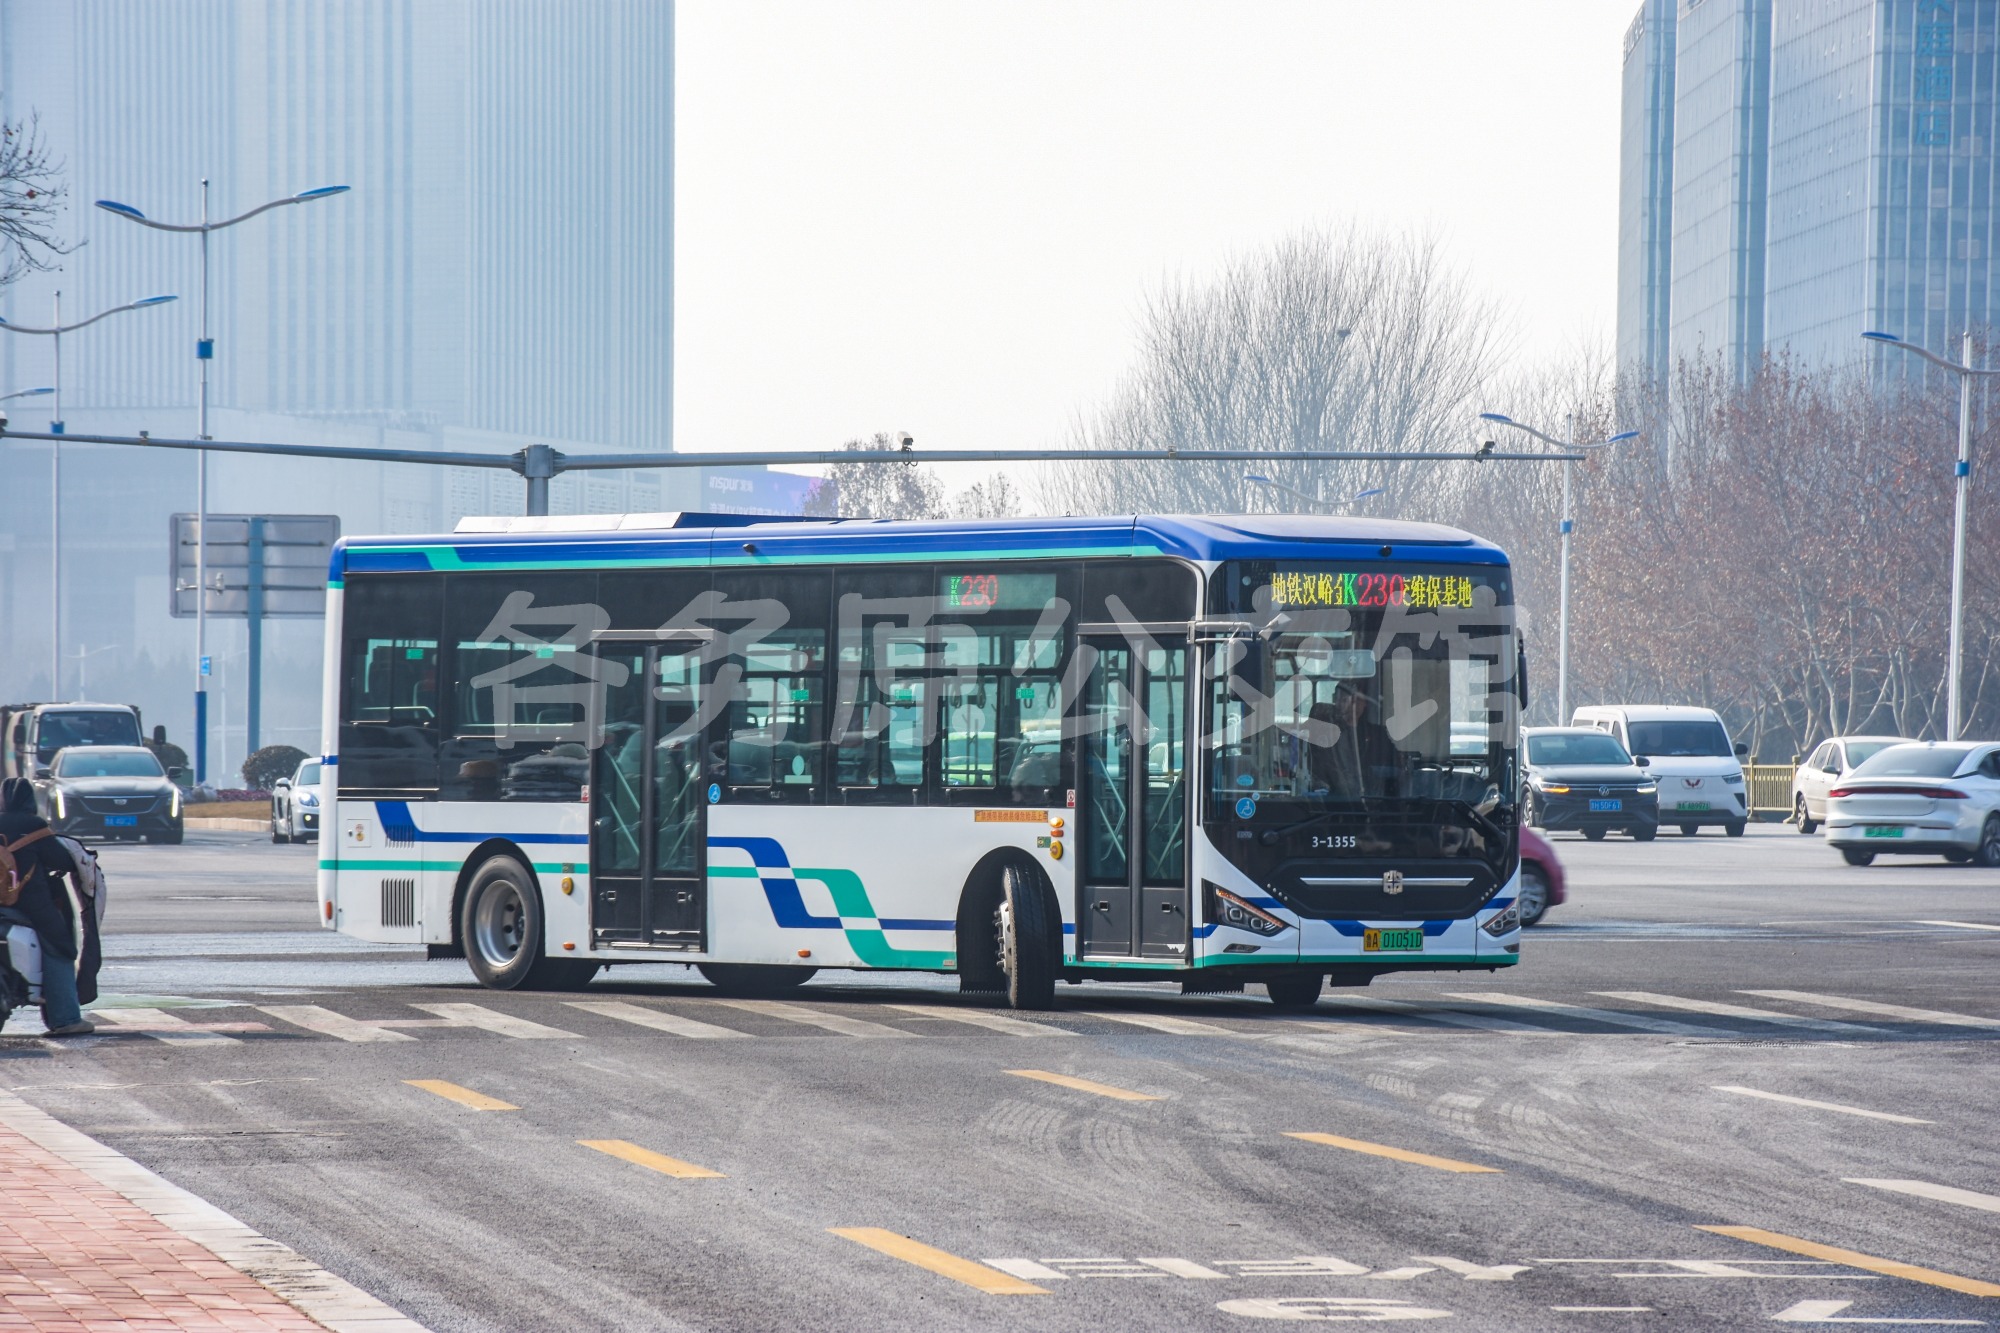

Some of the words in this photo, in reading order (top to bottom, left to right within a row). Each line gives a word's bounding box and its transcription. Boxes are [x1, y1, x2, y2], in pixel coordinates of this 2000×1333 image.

[949, 574, 998, 606] K230
[1343, 573, 1404, 606] K230
[1312, 836, 1356, 848] 3-1355
